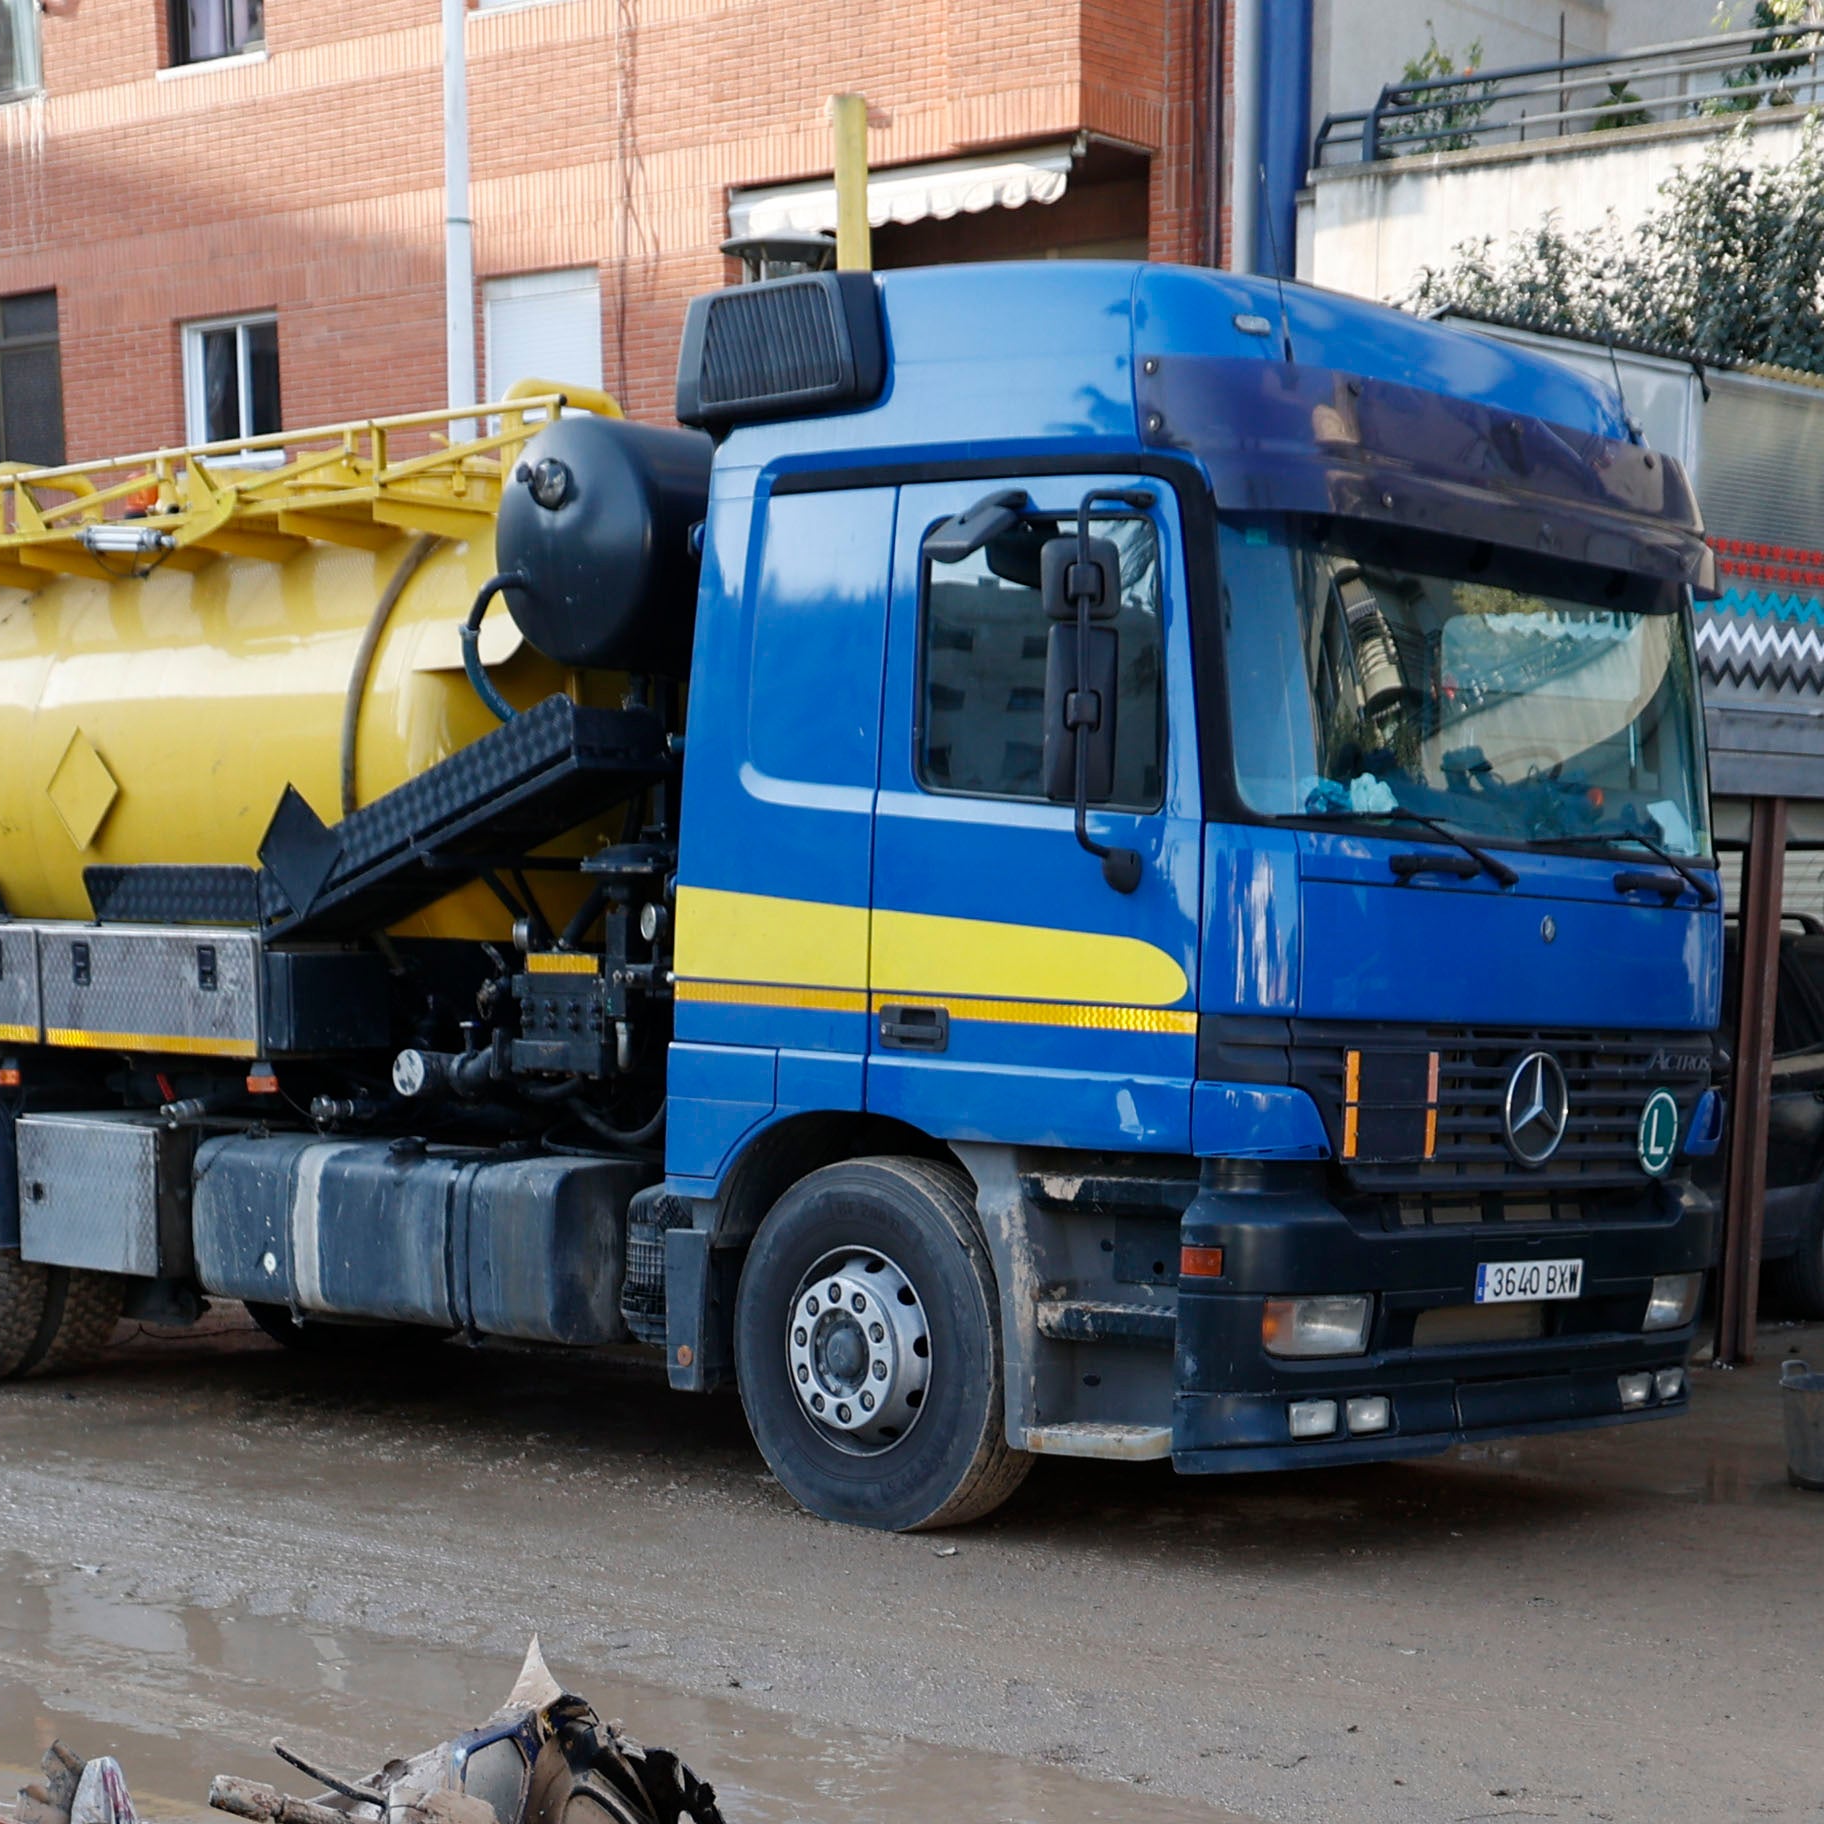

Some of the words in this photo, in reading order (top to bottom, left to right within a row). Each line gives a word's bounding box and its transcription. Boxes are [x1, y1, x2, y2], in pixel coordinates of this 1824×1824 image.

[1649, 1108, 1665, 1155] L
[1493, 1266, 1541, 1297] 3640
[1546, 1264, 1580, 1294] BXW
